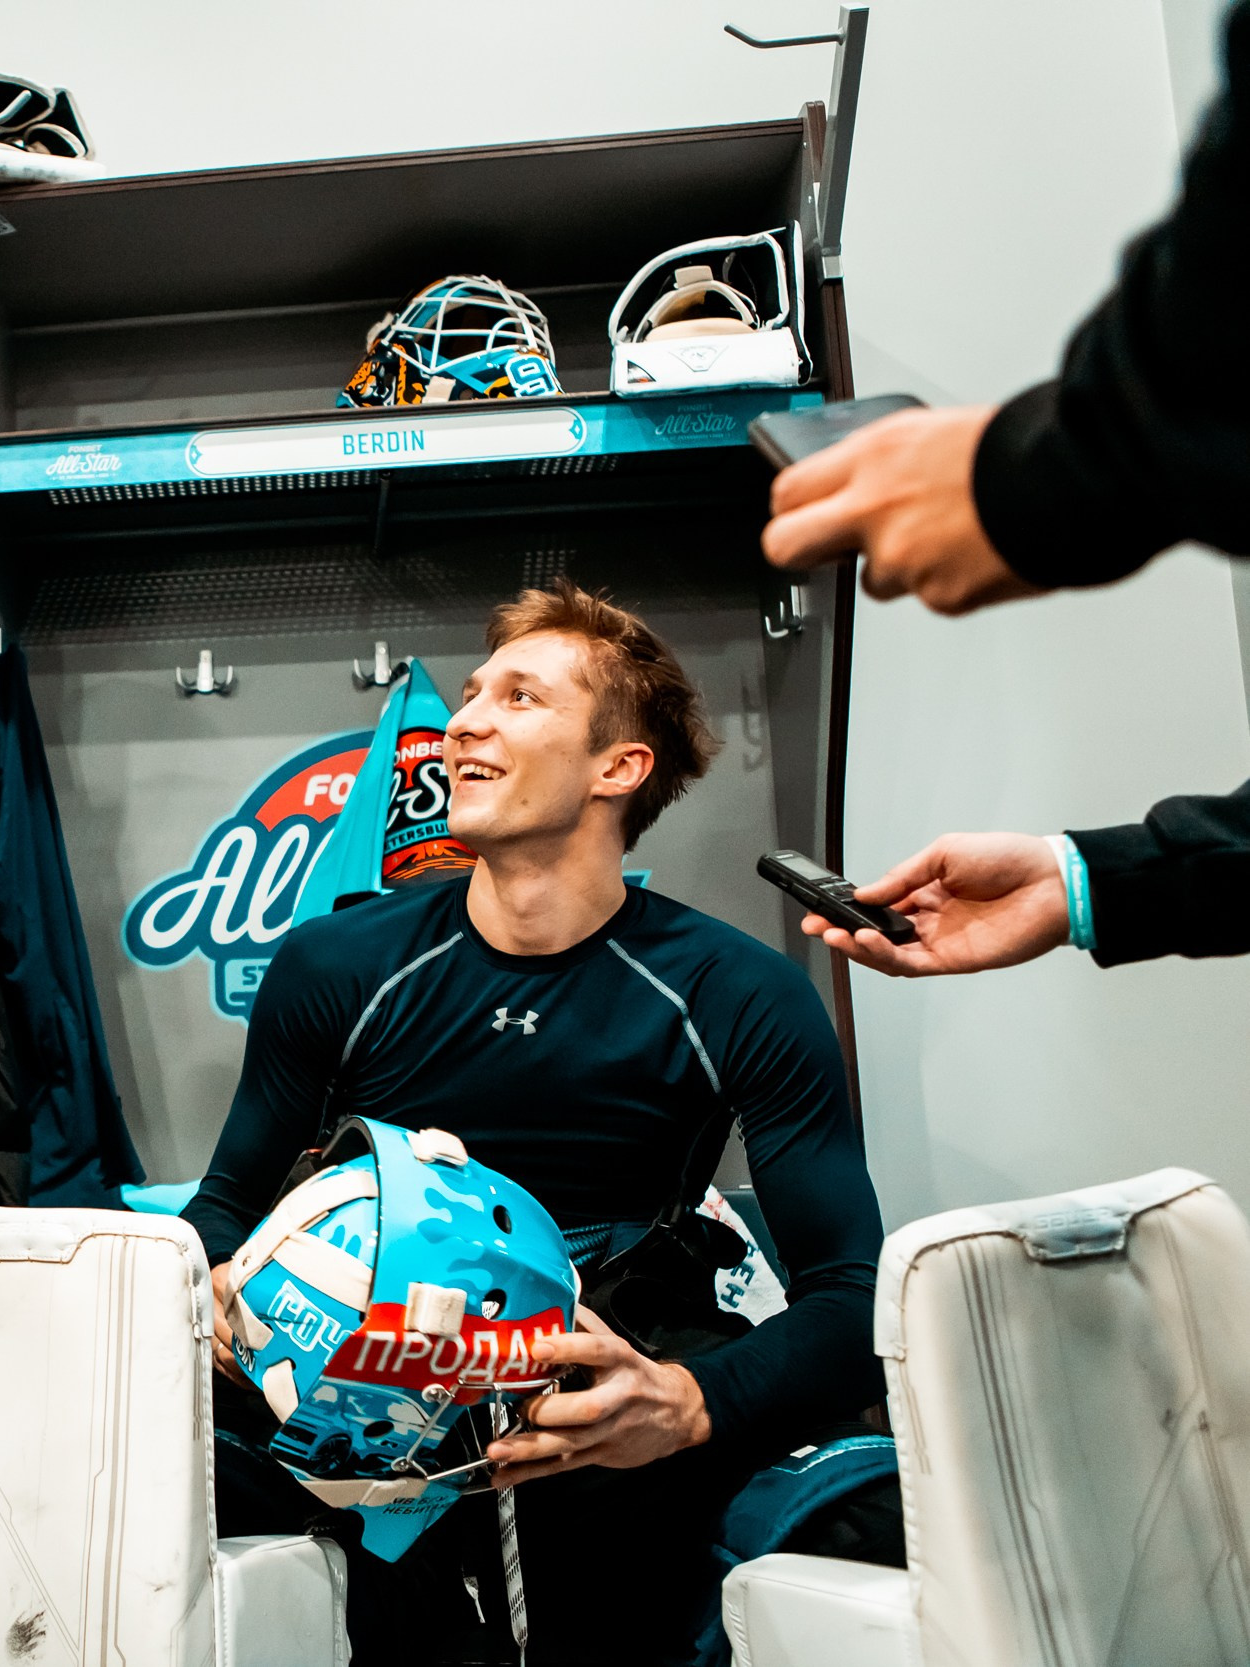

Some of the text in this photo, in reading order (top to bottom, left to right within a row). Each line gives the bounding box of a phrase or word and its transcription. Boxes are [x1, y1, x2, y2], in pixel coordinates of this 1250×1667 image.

[655, 412, 736, 436] All-Star
[342, 429, 425, 456] BERDIN
[46, 453, 122, 476] All-Star
[304, 773, 356, 806] FO
